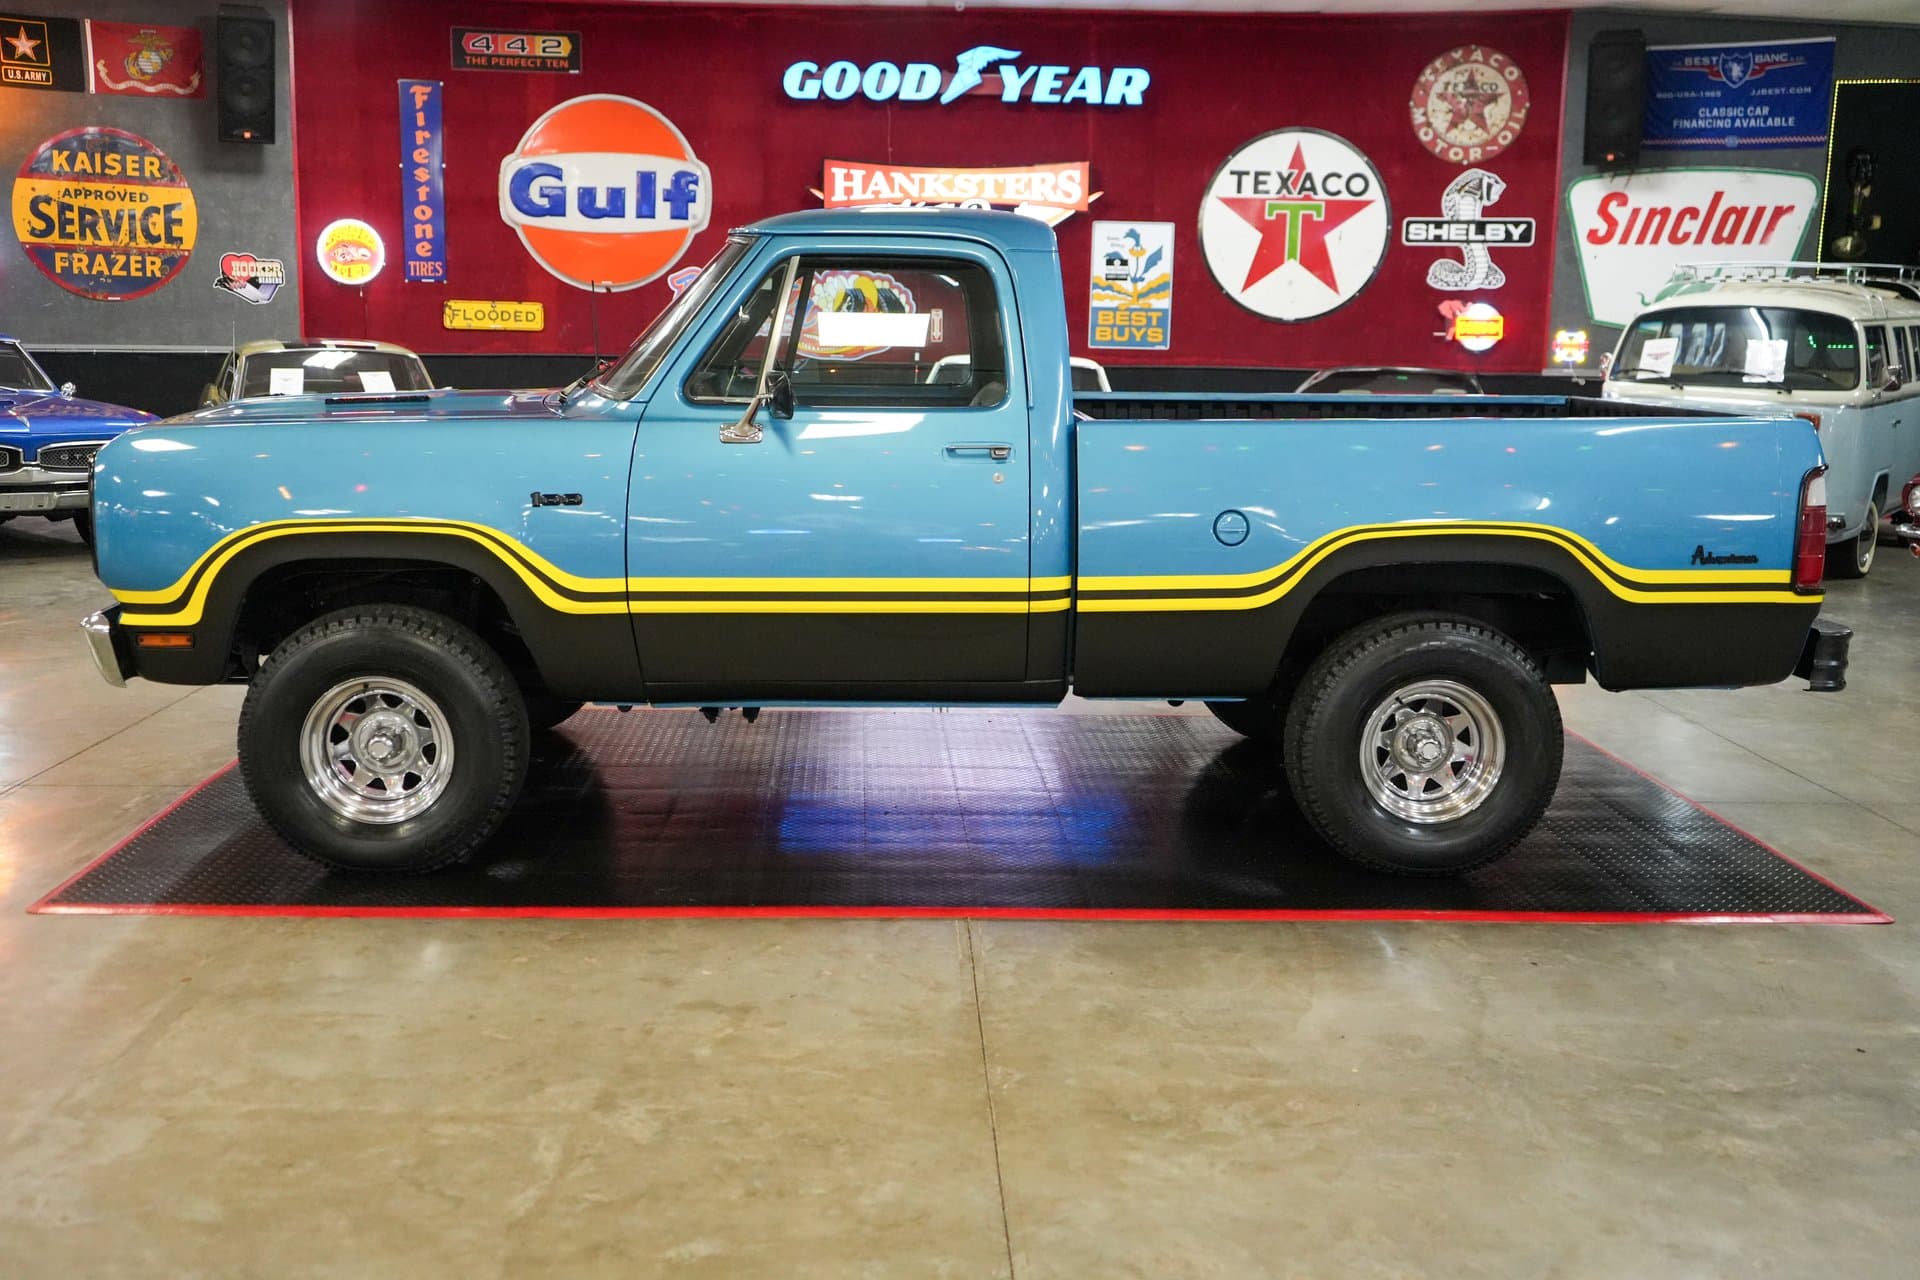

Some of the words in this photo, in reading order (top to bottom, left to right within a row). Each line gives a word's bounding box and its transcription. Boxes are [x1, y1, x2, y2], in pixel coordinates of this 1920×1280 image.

[465, 55, 488, 65] THE
[491, 57, 540, 67] PERFECT
[545, 59, 569, 68] TEN
[1684, 56, 1719, 66] BEST
[1754, 53, 1789, 64] BANC
[7, 69, 24, 80] U.S.
[24, 71, 47, 82] ARMY
[1698, 106, 1745, 118] CLASSIC
[1748, 106, 1770, 116] CAR
[1673, 118, 1732, 129] FINANCING
[1735, 116, 1796, 127] AVAILABLE
[52, 150, 161, 178] KAISER
[408, 84, 433, 258] Firestone
[509, 162, 700, 221] Gulf
[831, 167, 1082, 205] HANKSTERS
[1230, 169, 1371, 198] TEXACO
[61, 187, 150, 203] APPROVED
[28, 194, 184, 247] SERVICE
[1587, 191, 1795, 246] Sinclair
[1407, 222, 1529, 242] SHELBY
[54, 252, 163, 278] FRAZER
[408, 261, 443, 277] TIRES
[450, 308, 537, 323] FLOODED
[1097, 310, 1163, 326] BEST
[1095, 326, 1164, 343] BUYS
